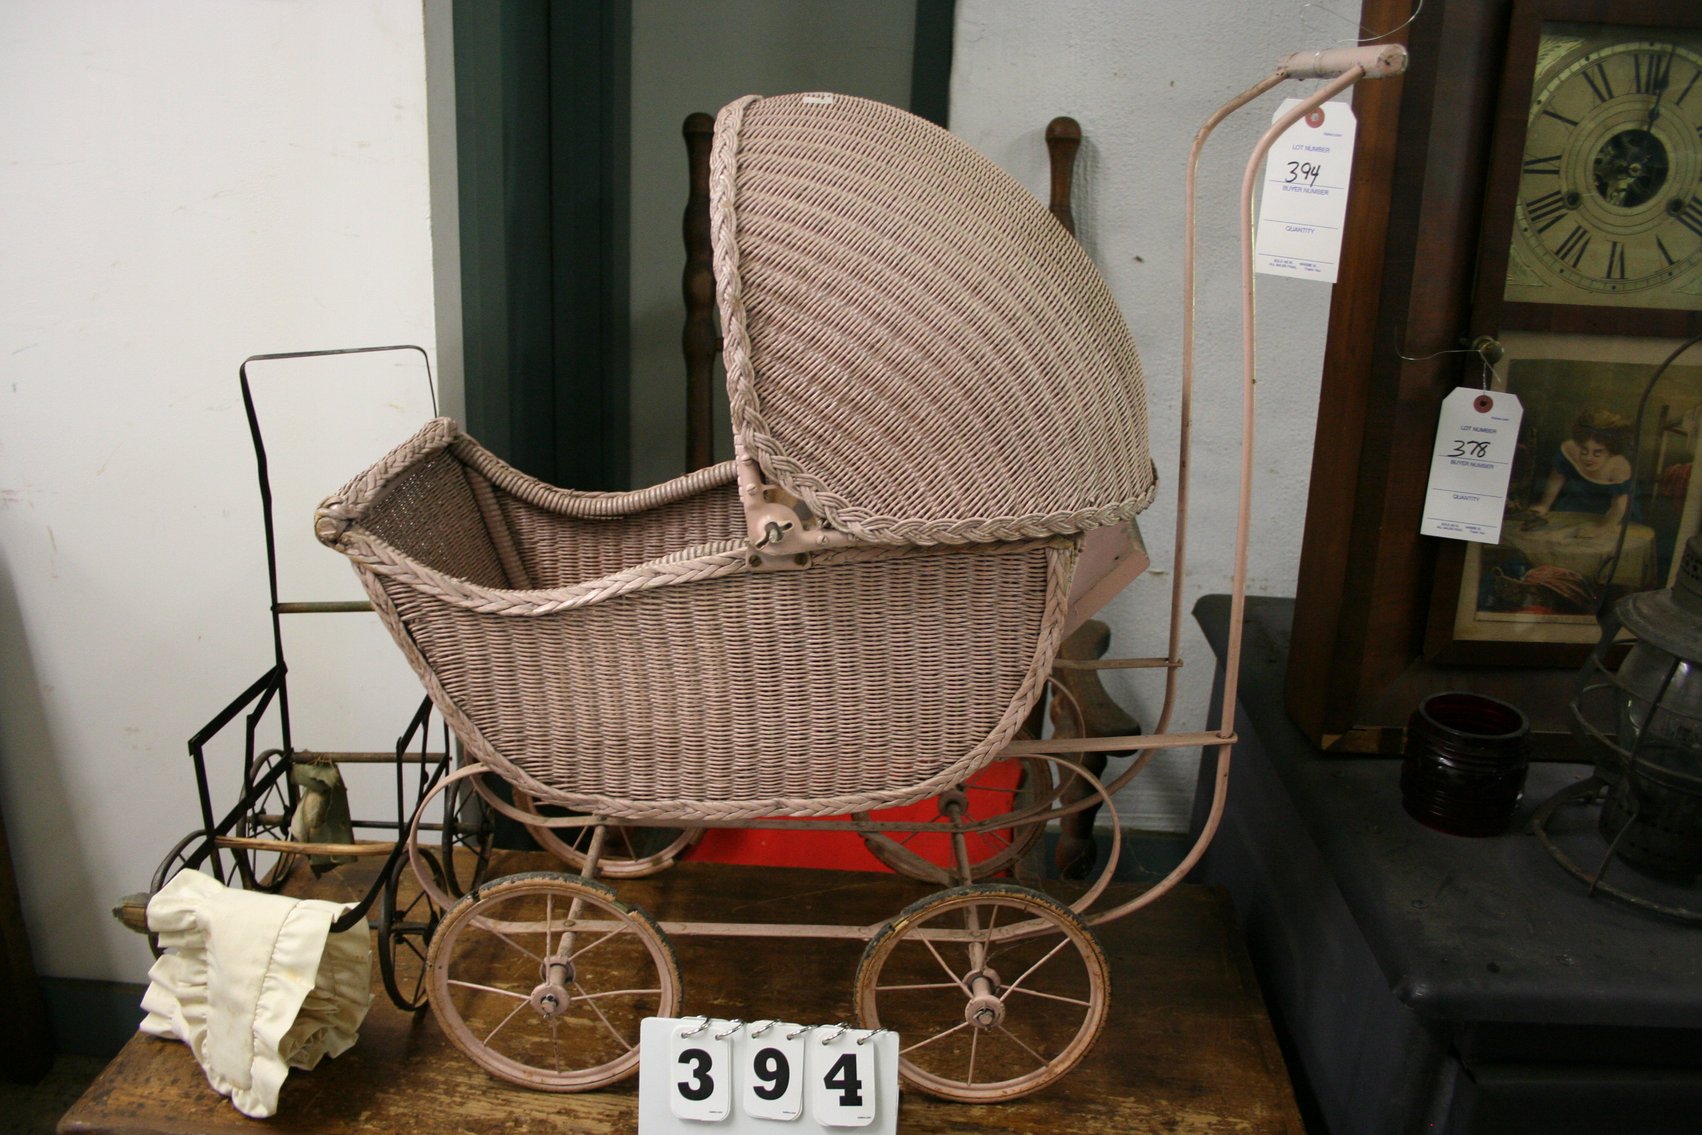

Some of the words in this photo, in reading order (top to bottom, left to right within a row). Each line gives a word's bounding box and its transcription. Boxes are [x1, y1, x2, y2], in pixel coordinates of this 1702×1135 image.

[1304, 145, 1330, 153] NUMBER
[1285, 161, 1321, 187] 394
[1282, 185, 1302, 193] BUYER
[1303, 187, 1329, 196] NUMBER
[1285, 225, 1315, 234] QUANTITY
[1447, 439, 1491, 458] 378
[1453, 494, 1480, 502] QUANTITY
